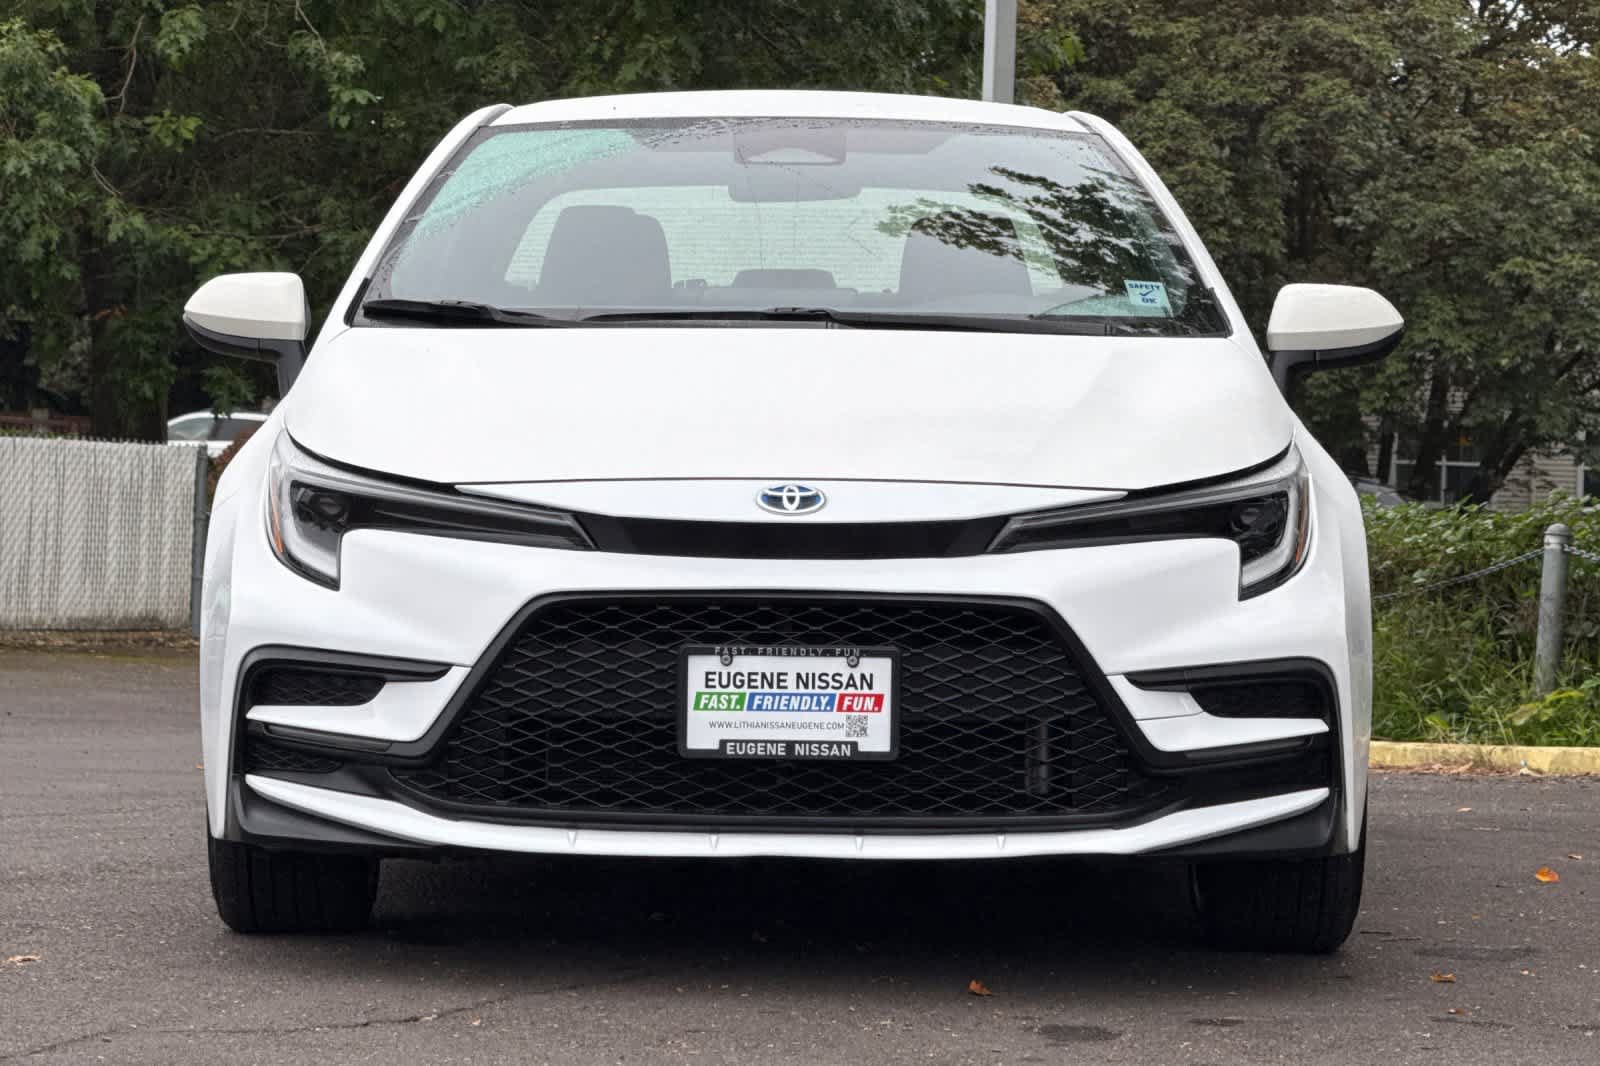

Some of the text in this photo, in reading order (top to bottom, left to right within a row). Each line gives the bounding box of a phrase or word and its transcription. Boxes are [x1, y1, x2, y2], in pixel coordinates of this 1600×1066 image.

[704, 671, 873, 690] EUGENE NISSAN
[699, 694, 879, 711] FAST. FRIENDLY. FUN.
[709, 721, 844, 730] WWW.LITHIANISSANEUGENE.COM
[726, 742, 851, 756] EUGENE NISSAN
